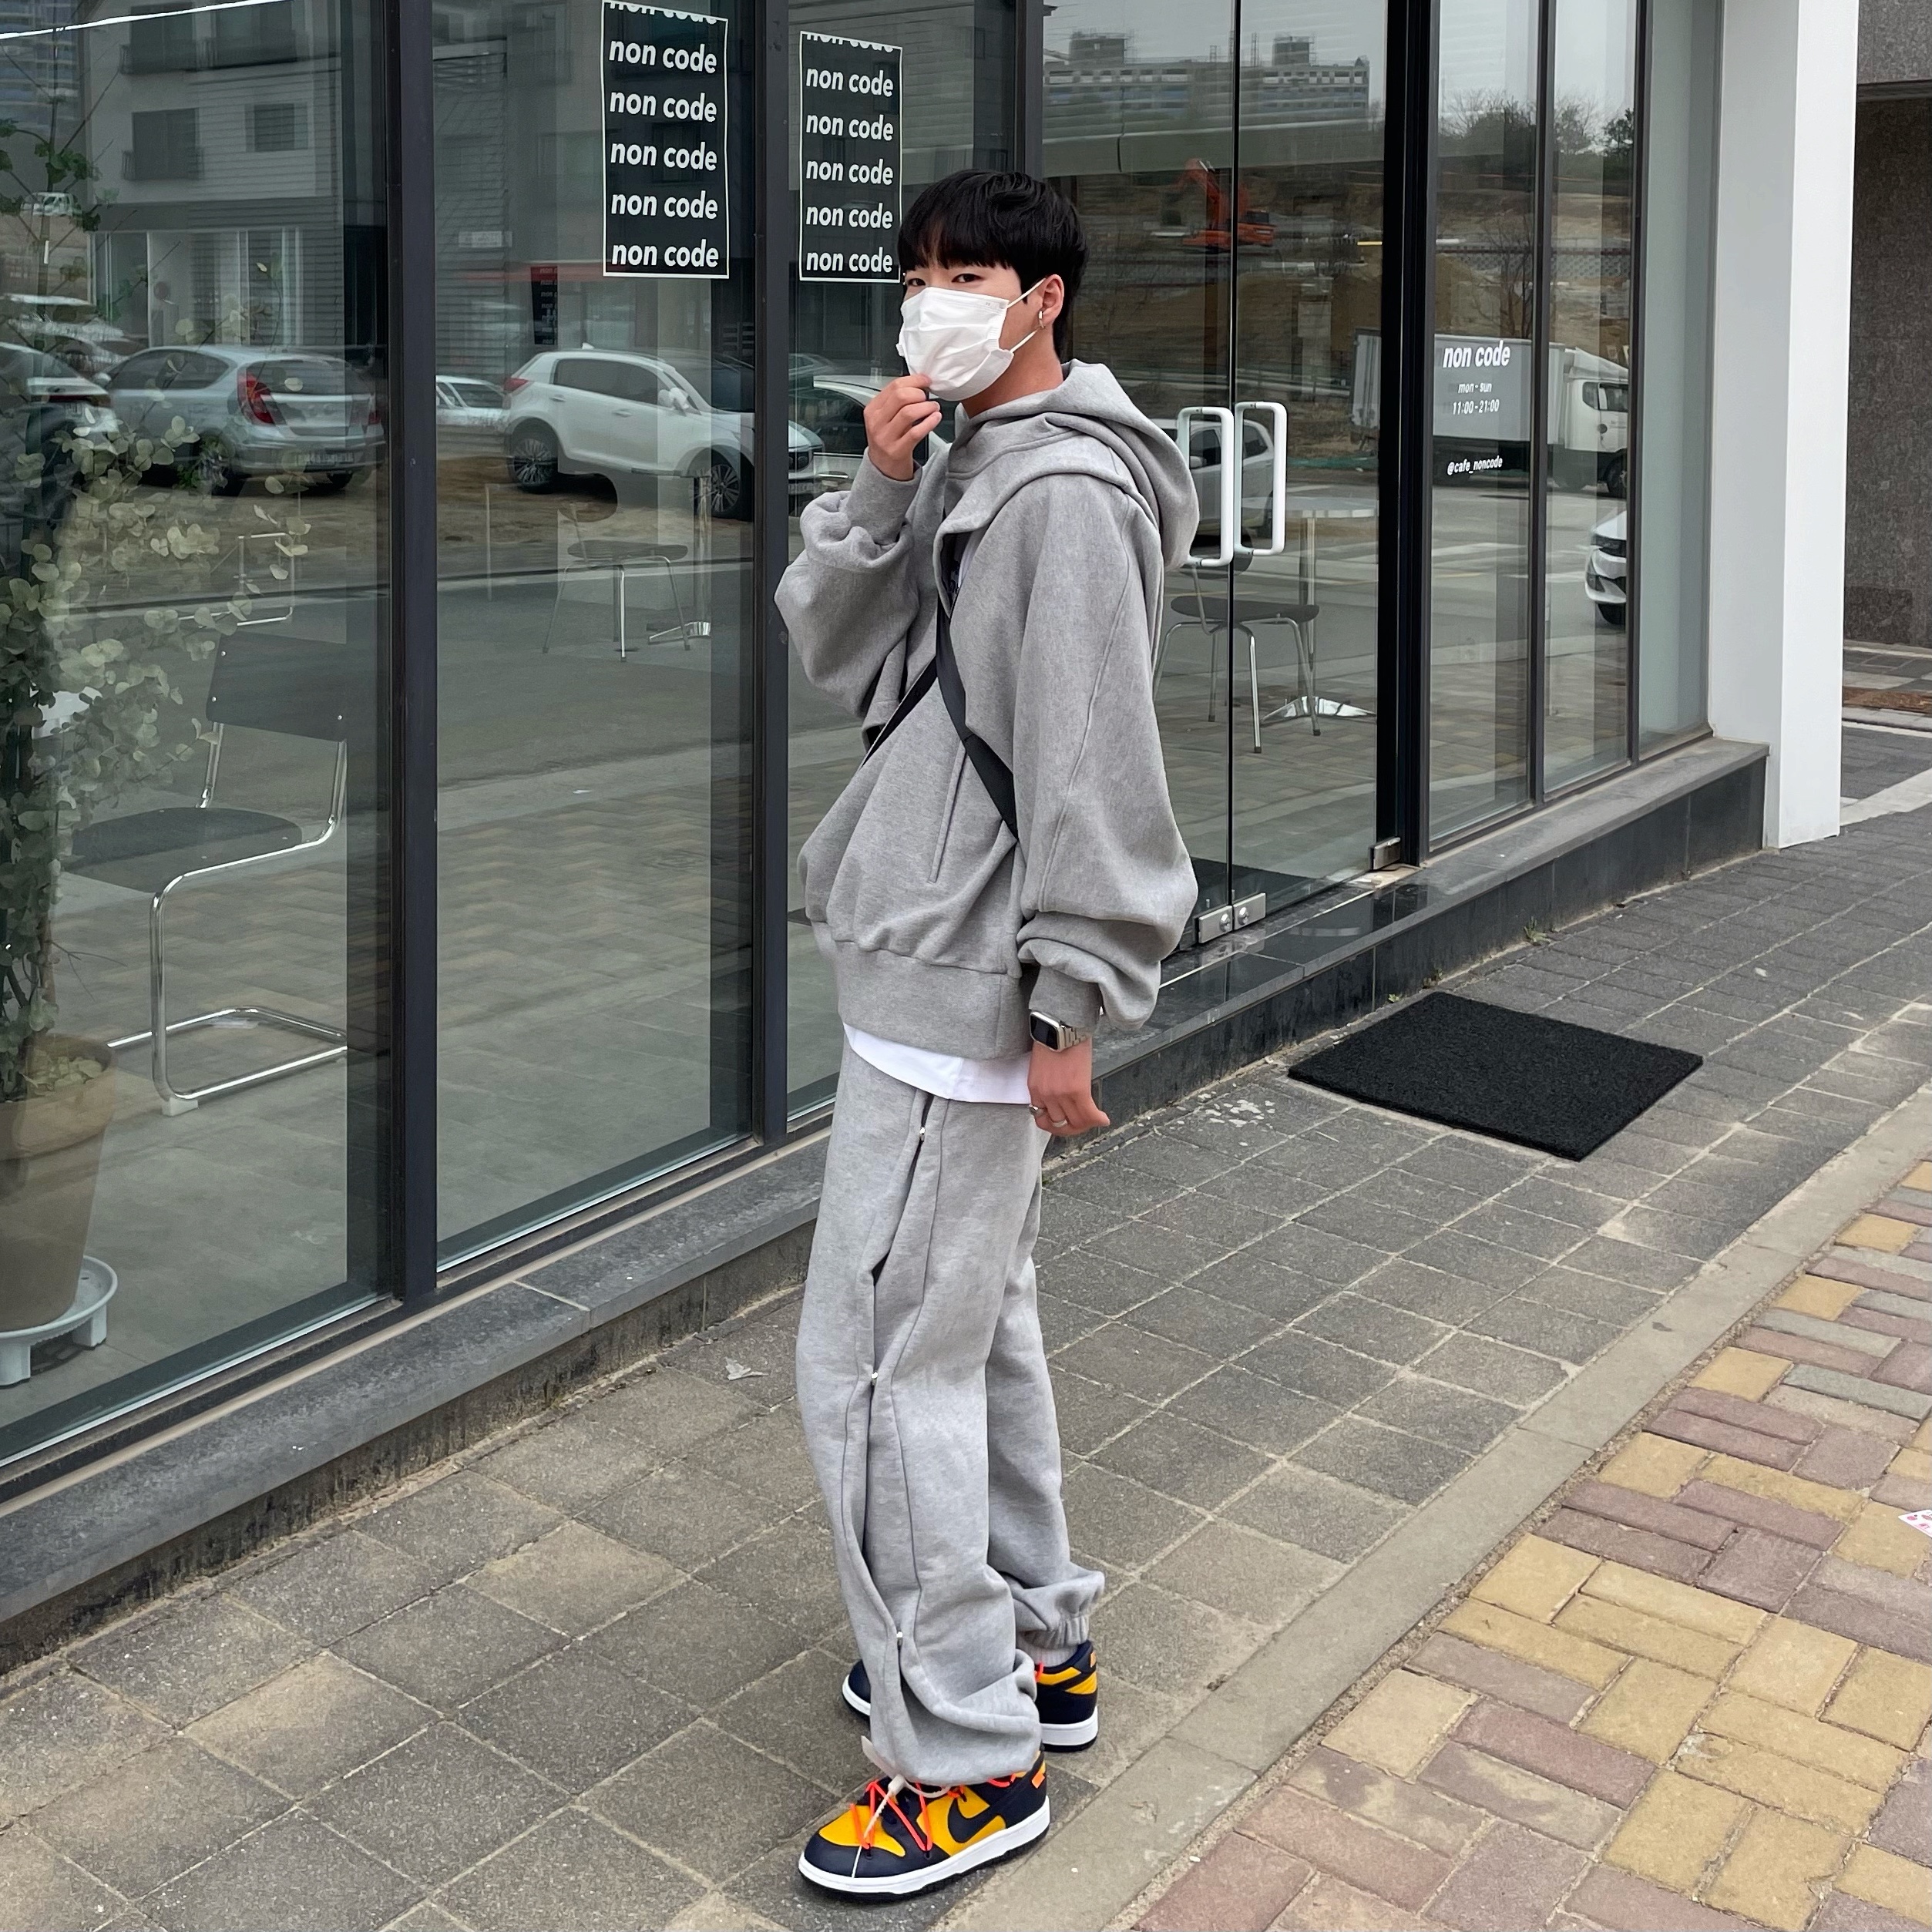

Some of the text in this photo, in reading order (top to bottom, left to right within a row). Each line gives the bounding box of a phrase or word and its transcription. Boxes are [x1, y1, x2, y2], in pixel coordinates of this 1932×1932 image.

[609, 40, 717, 74] non code
[805, 68, 894, 97] non code
[610, 92, 717, 123] non code
[805, 114, 894, 141] non code
[610, 141, 717, 171] non code
[805, 158, 894, 186] non code
[611, 190, 718, 220] non code
[805, 202, 893, 229] non code
[611, 238, 719, 267] non code
[806, 247, 893, 273] non code
[1443, 339, 1510, 368] non code
[1446, 455, 1503, 475] @cafe_noncode
